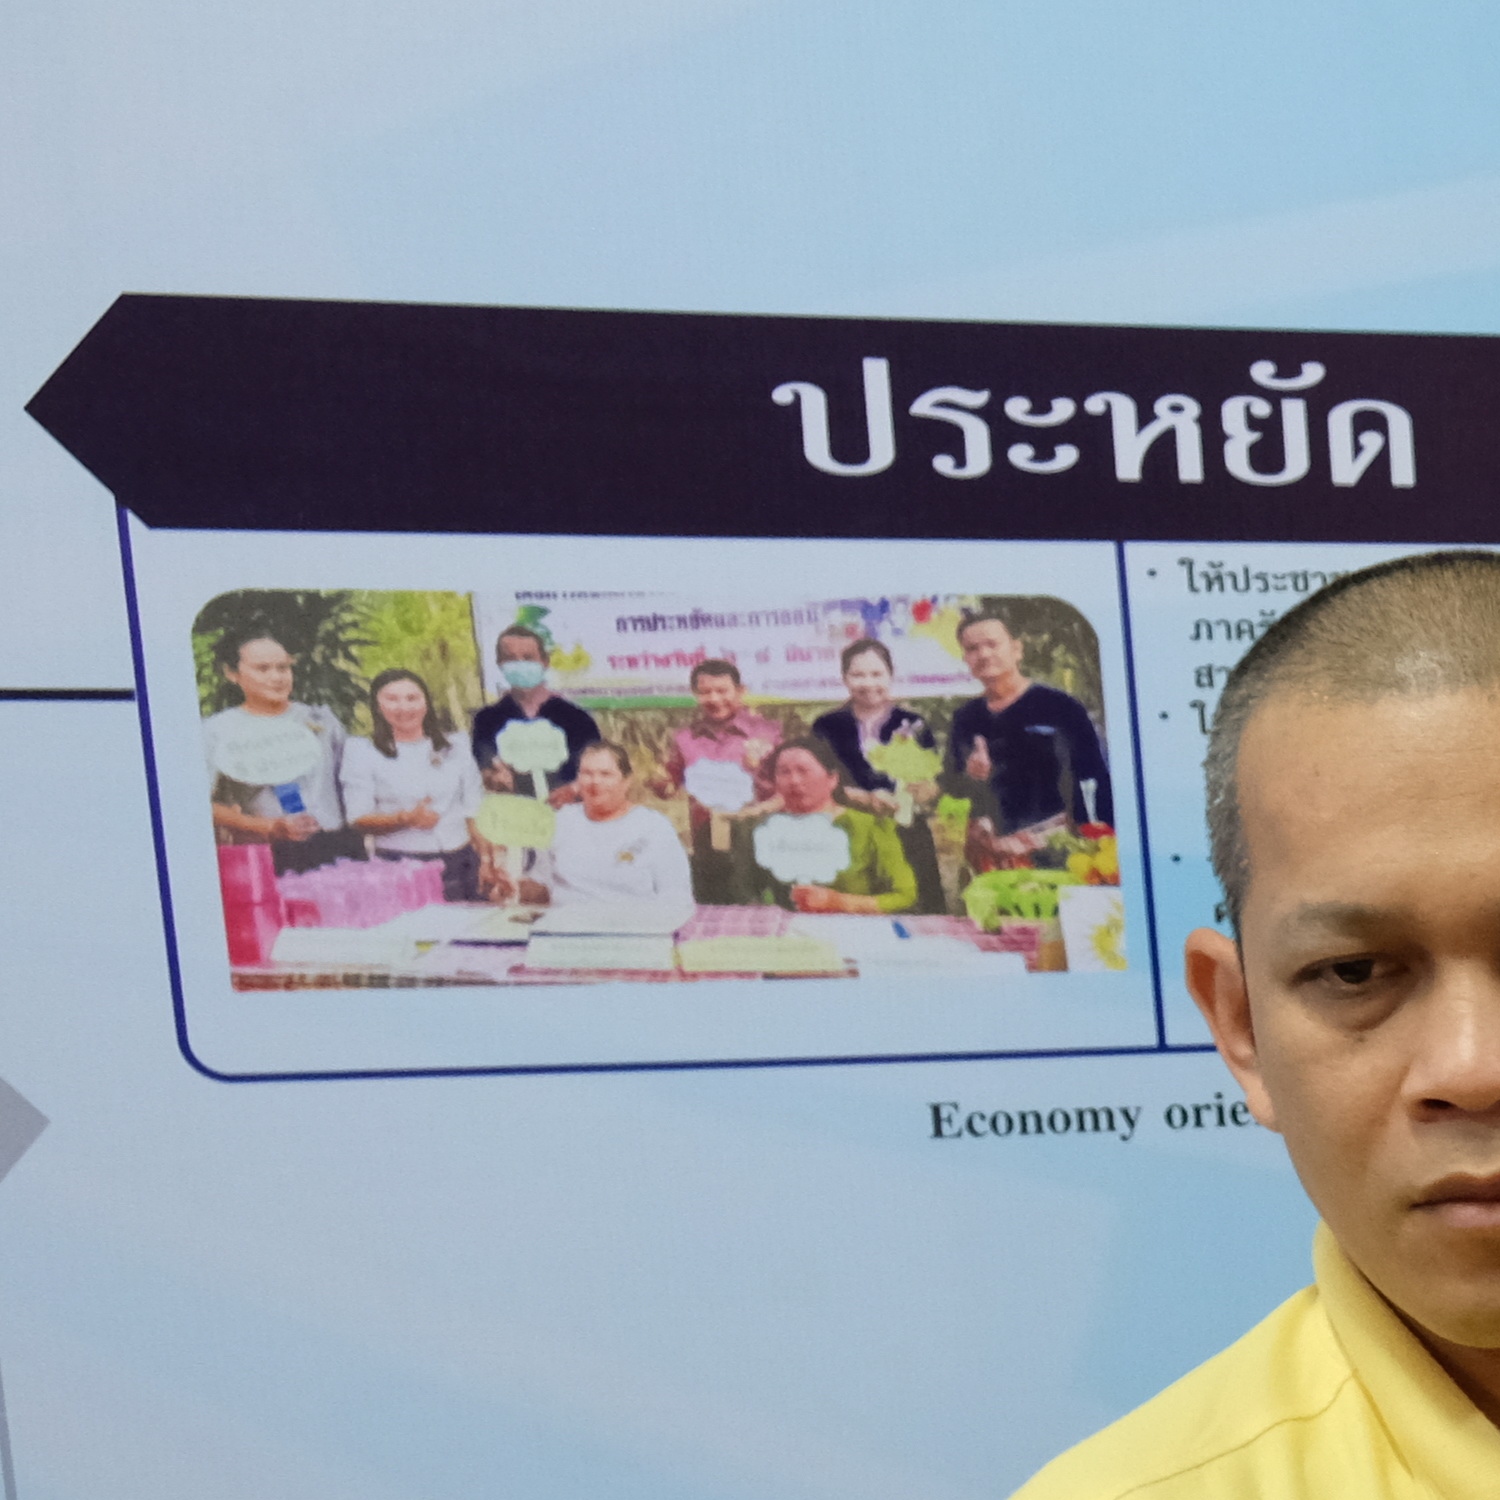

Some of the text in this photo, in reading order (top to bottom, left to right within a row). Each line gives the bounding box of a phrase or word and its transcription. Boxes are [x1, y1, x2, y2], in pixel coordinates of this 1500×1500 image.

[772, 357, 1416, 487] ประหยัด
[927, 1092, 1262, 1141] Economy orie
